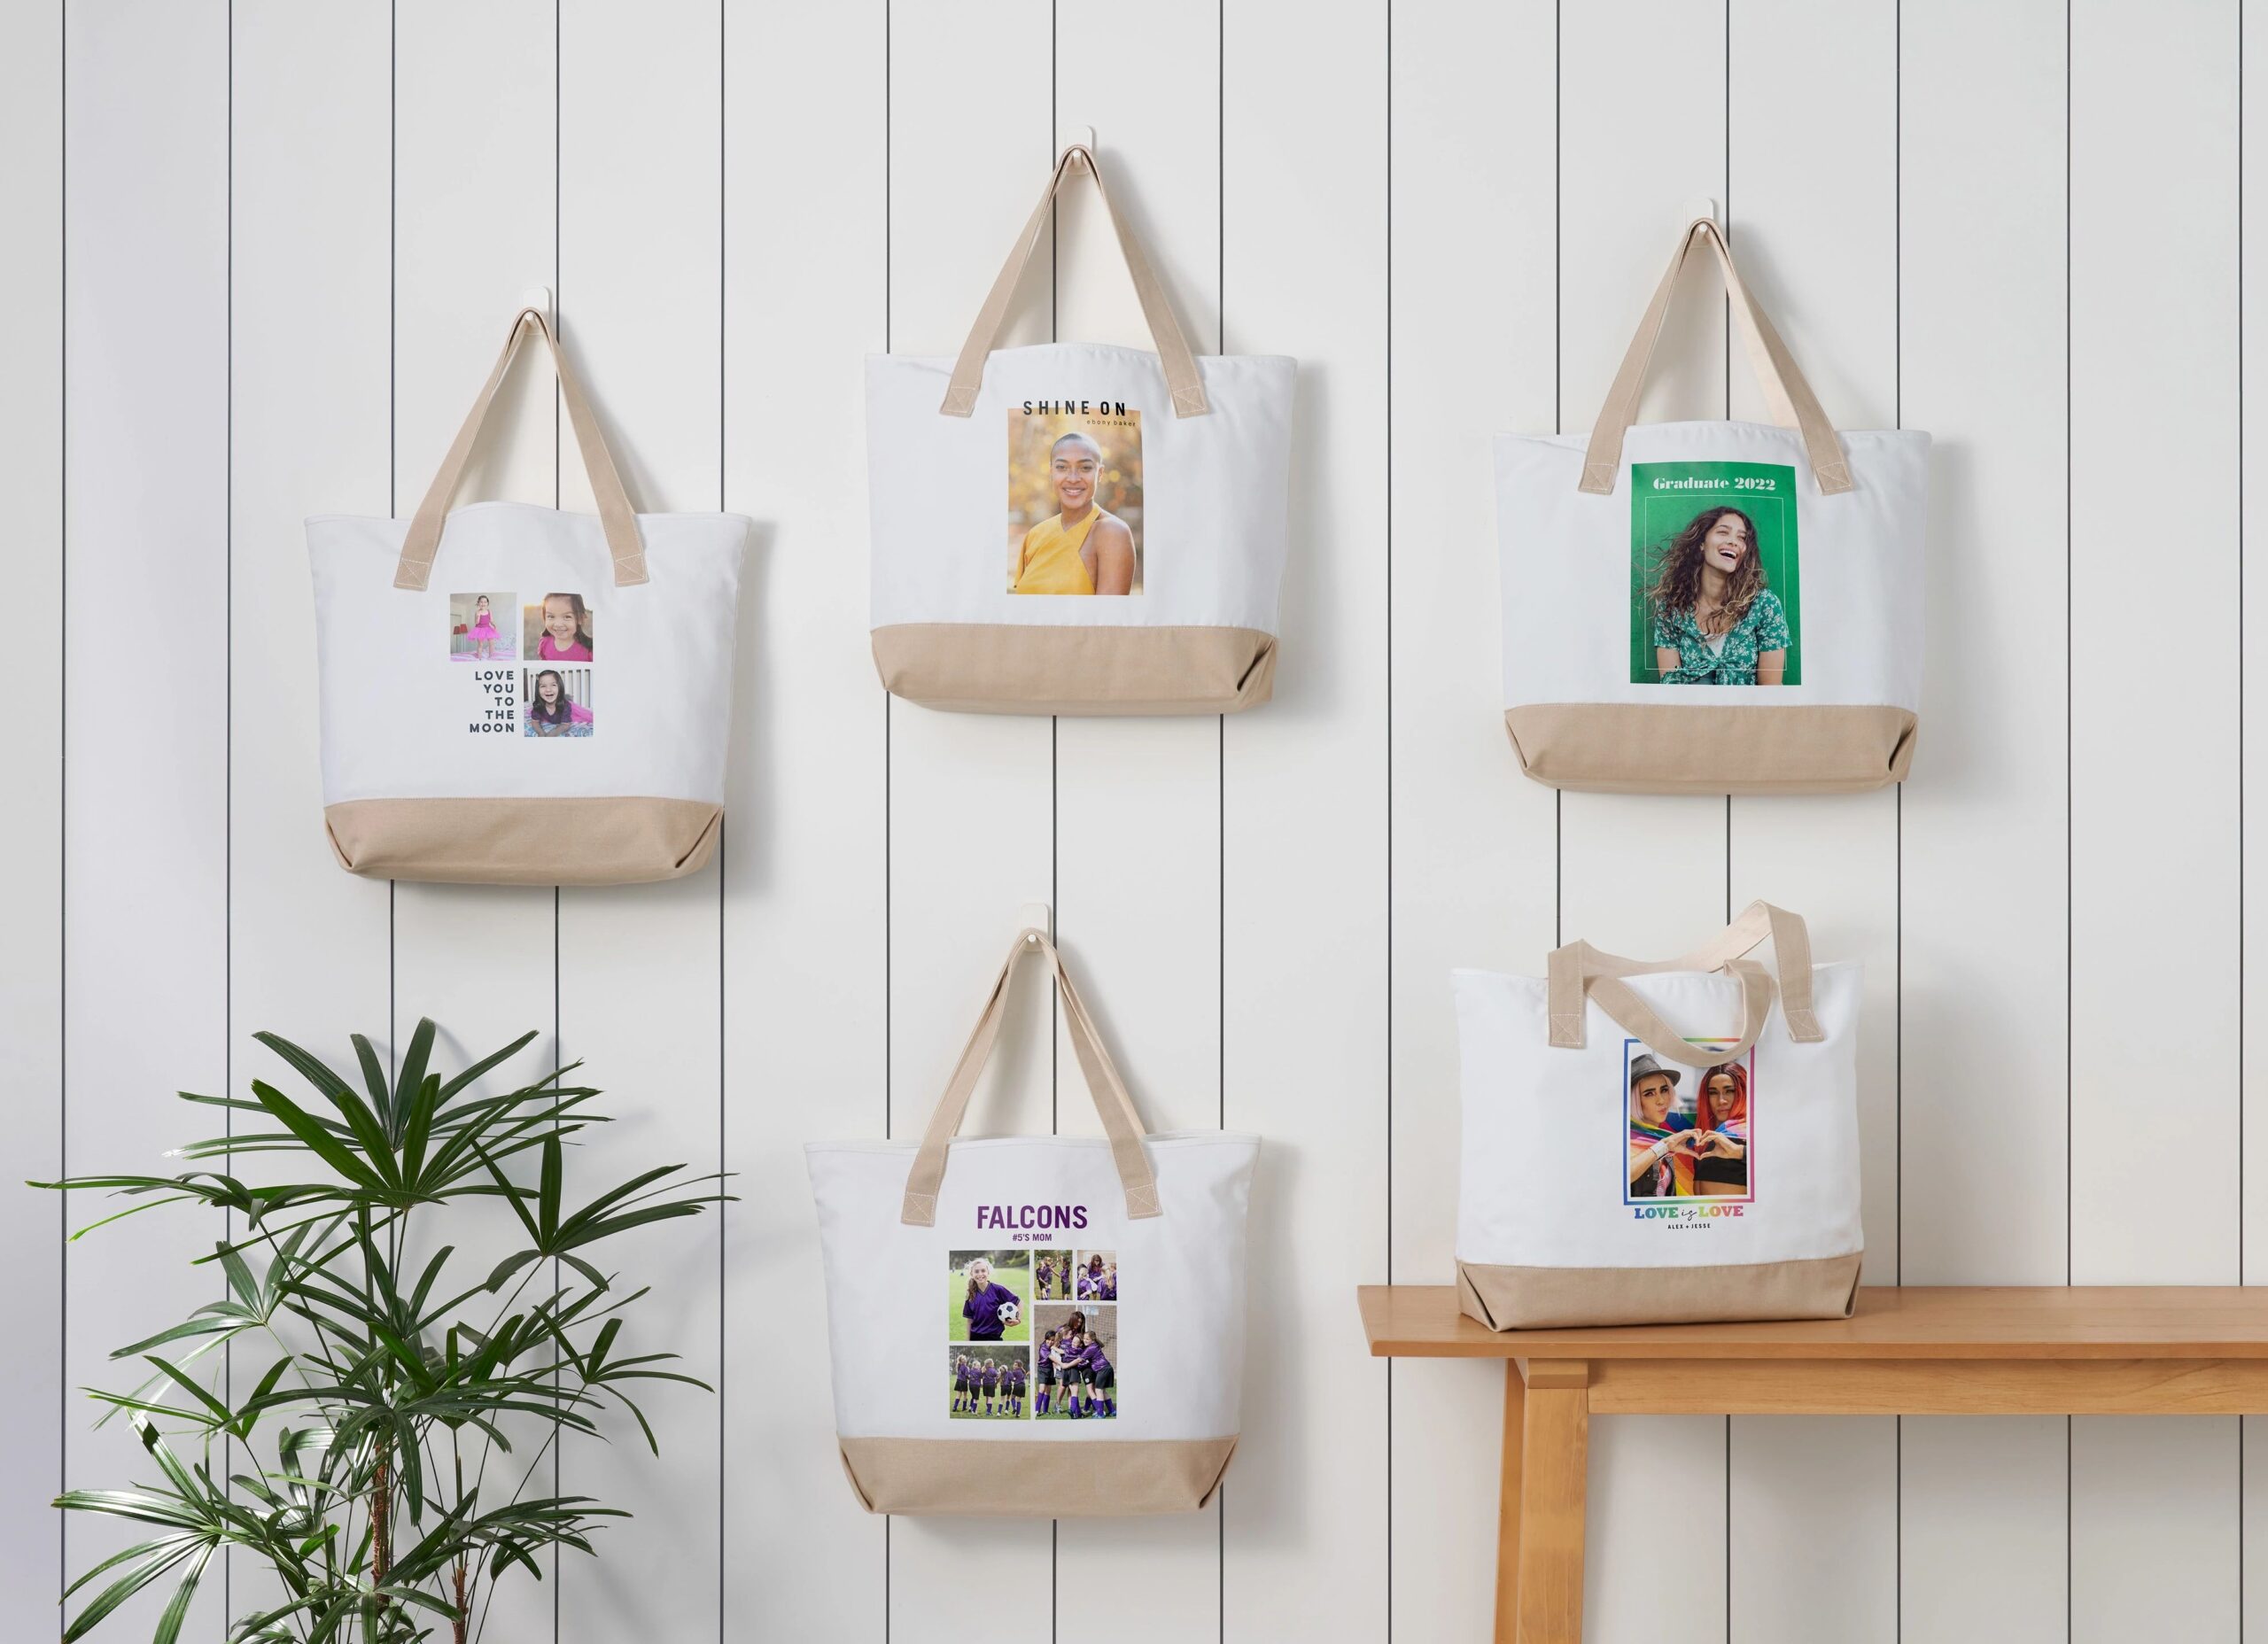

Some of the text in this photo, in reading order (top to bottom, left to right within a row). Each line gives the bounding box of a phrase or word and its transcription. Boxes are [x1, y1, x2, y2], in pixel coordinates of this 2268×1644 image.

[1023, 400, 1126, 416] SHINE ON
[1653, 477, 1776, 491] Graduate 2022
[475, 671, 515, 681] LOVE
[483, 684, 515, 694] YOU
[494, 696, 515, 707] TO
[485, 710, 515, 720] THE
[469, 723, 515, 733] MOON
[976, 1205, 1088, 1229] FALCONS
[1634, 1206, 1744, 1221] LOVE is LOVE
[1012, 1233, 1052, 1242] #5'S MOM
